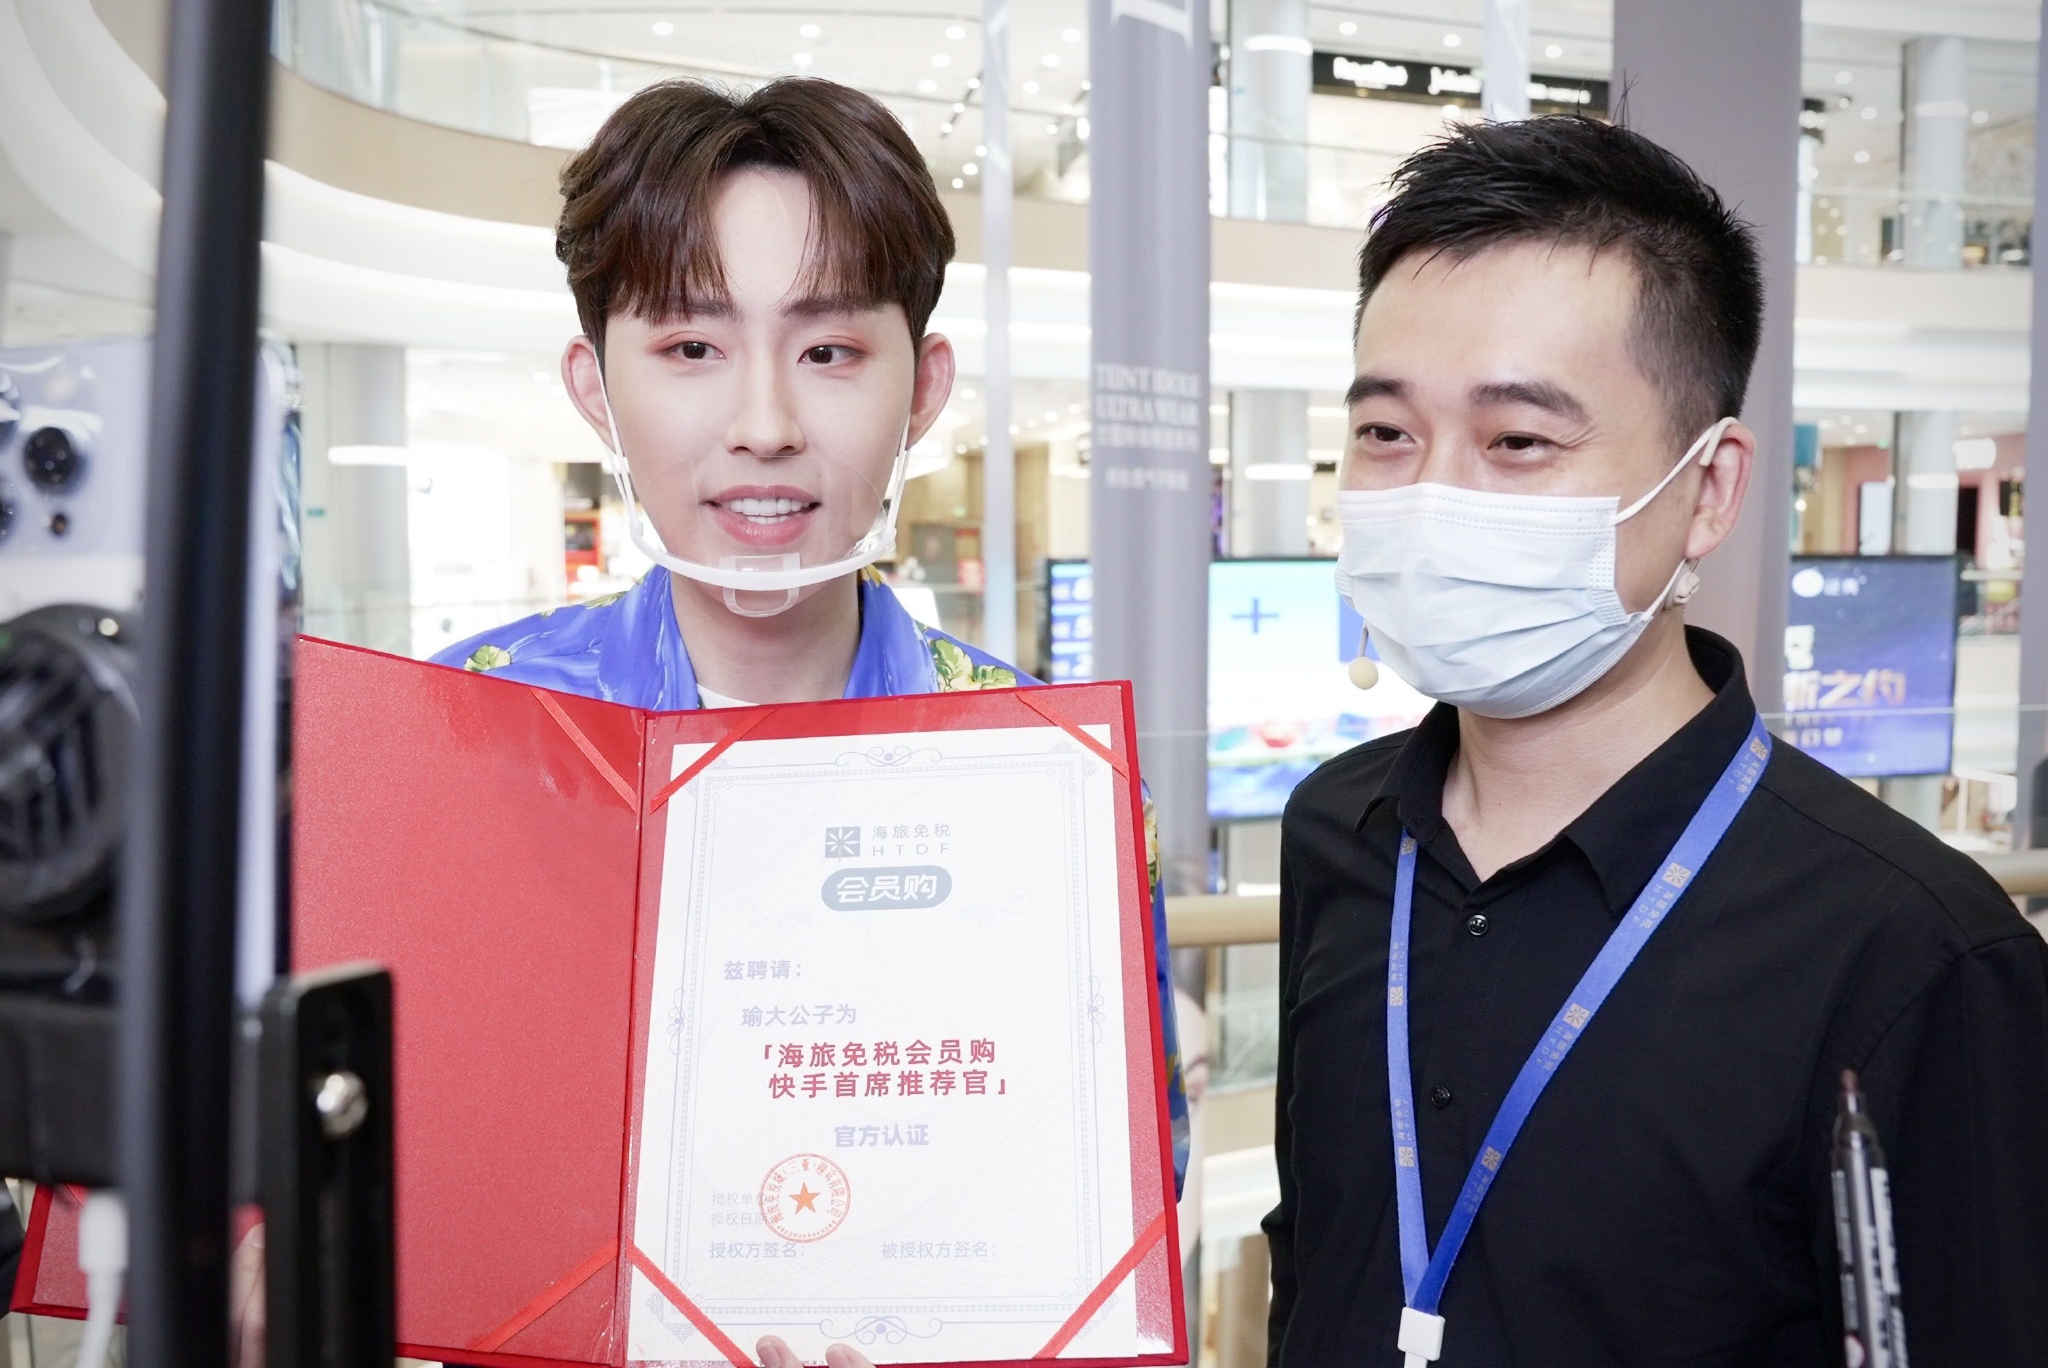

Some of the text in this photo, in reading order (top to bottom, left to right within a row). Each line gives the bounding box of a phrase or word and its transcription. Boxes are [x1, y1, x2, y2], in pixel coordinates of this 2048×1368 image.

[872, 822, 951, 840] 海旅免税
[872, 842, 949, 856] HTDF
[836, 873, 938, 903] 会员购
[723, 959, 802, 981] 兹聘请：
[741, 1003, 857, 1028] 瑜大公子为
[764, 1038, 996, 1068] 「海旅免税会员购
[768, 1069, 1006, 1099] 快手首席推荐官」
[834, 1124, 930, 1148] 官方认证
[709, 1240, 804, 1260] 授权方签名：
[881, 1240, 996, 1260] 被授权方签名：
